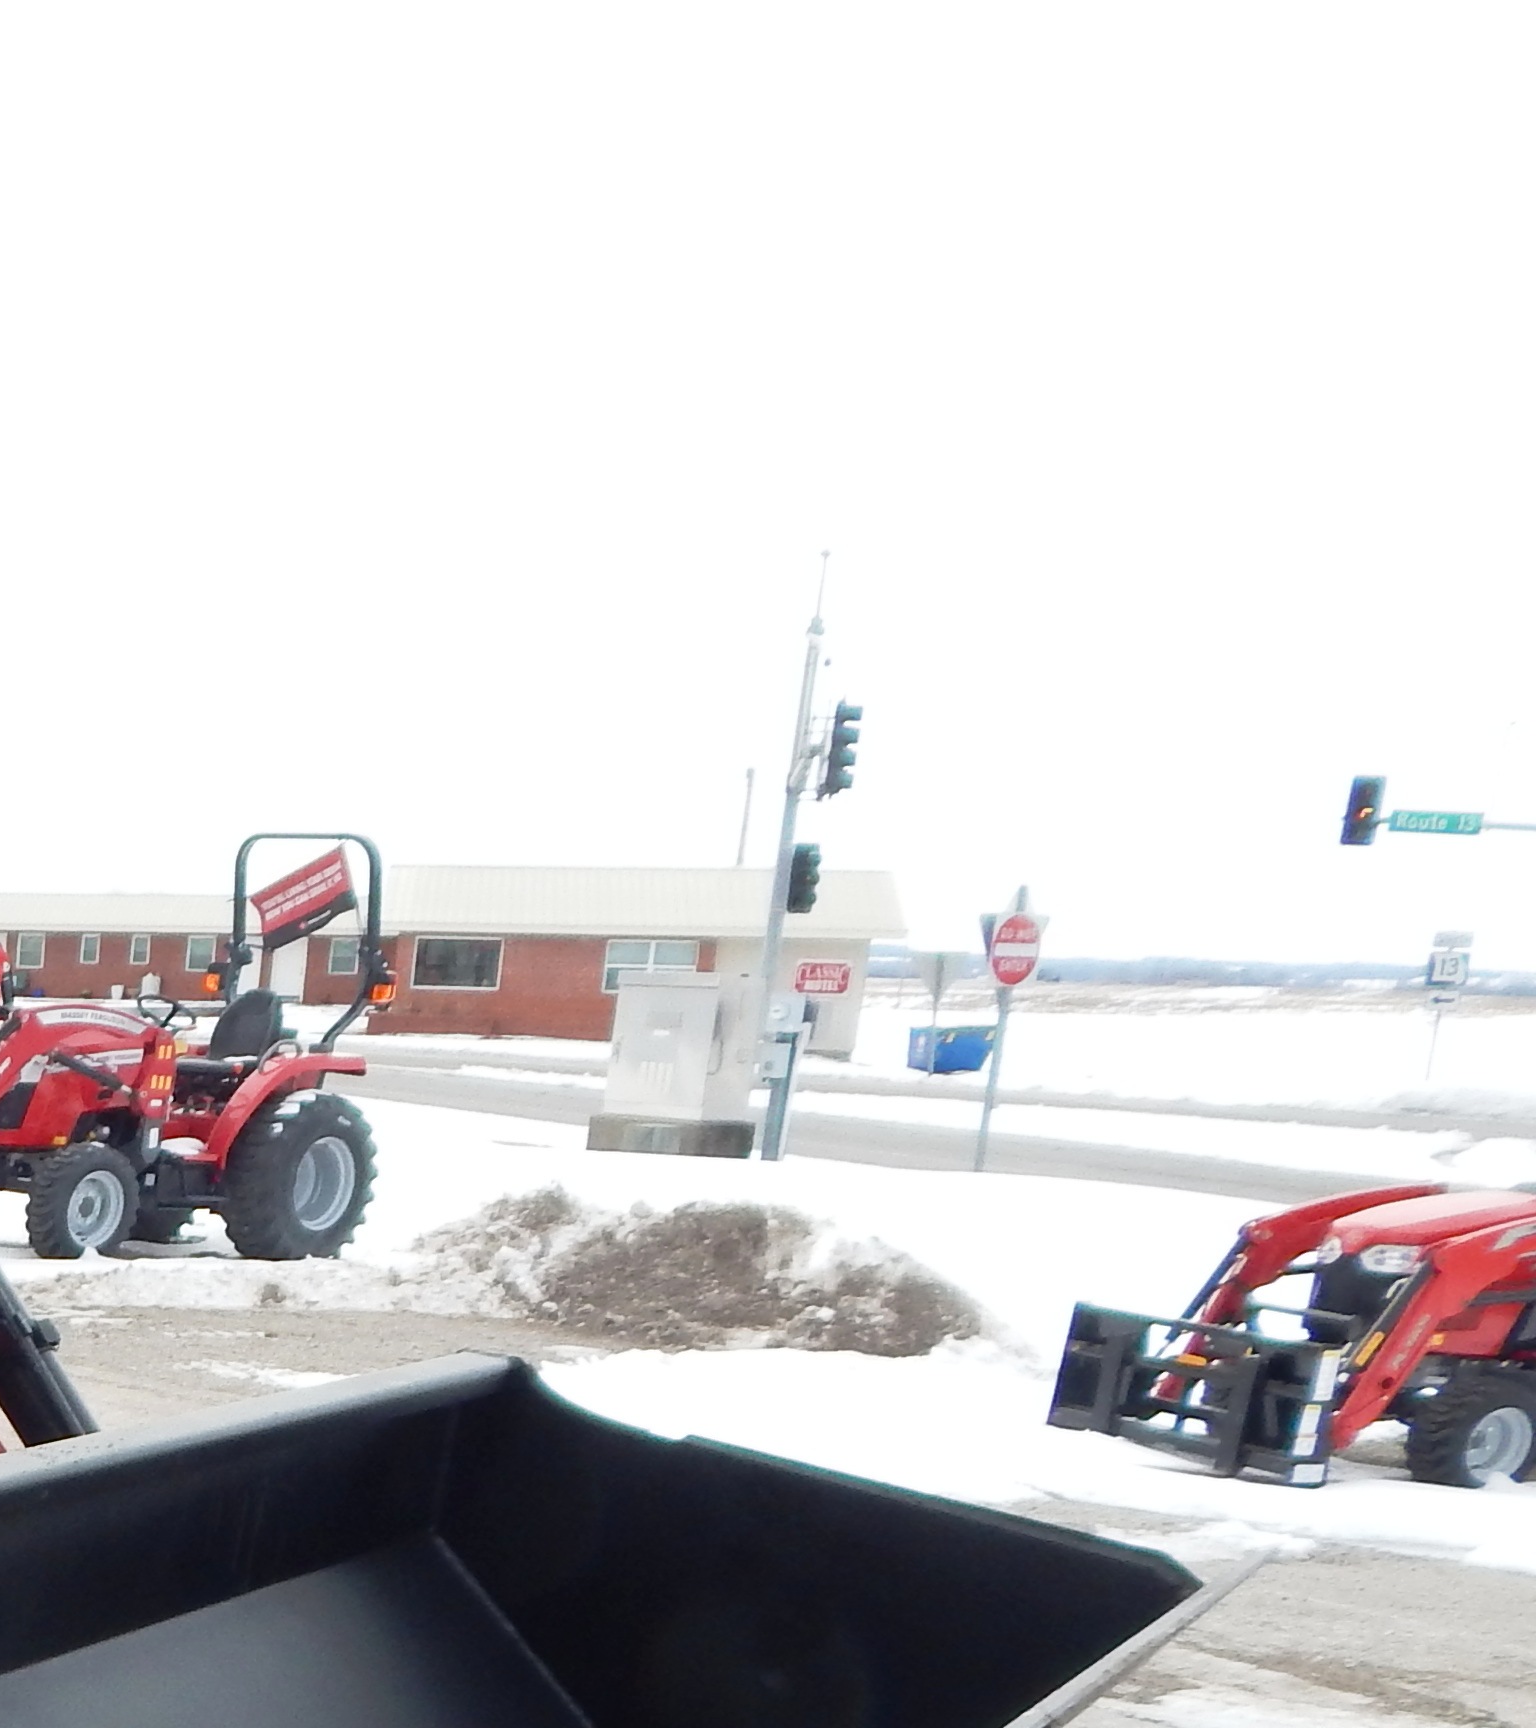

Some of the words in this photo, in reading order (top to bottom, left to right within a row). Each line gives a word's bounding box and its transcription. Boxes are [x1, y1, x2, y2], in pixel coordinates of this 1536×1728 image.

[1397, 811, 1448, 830] Route
[1458, 813, 1477, 831] 13
[1439, 957, 1459, 976] 13
